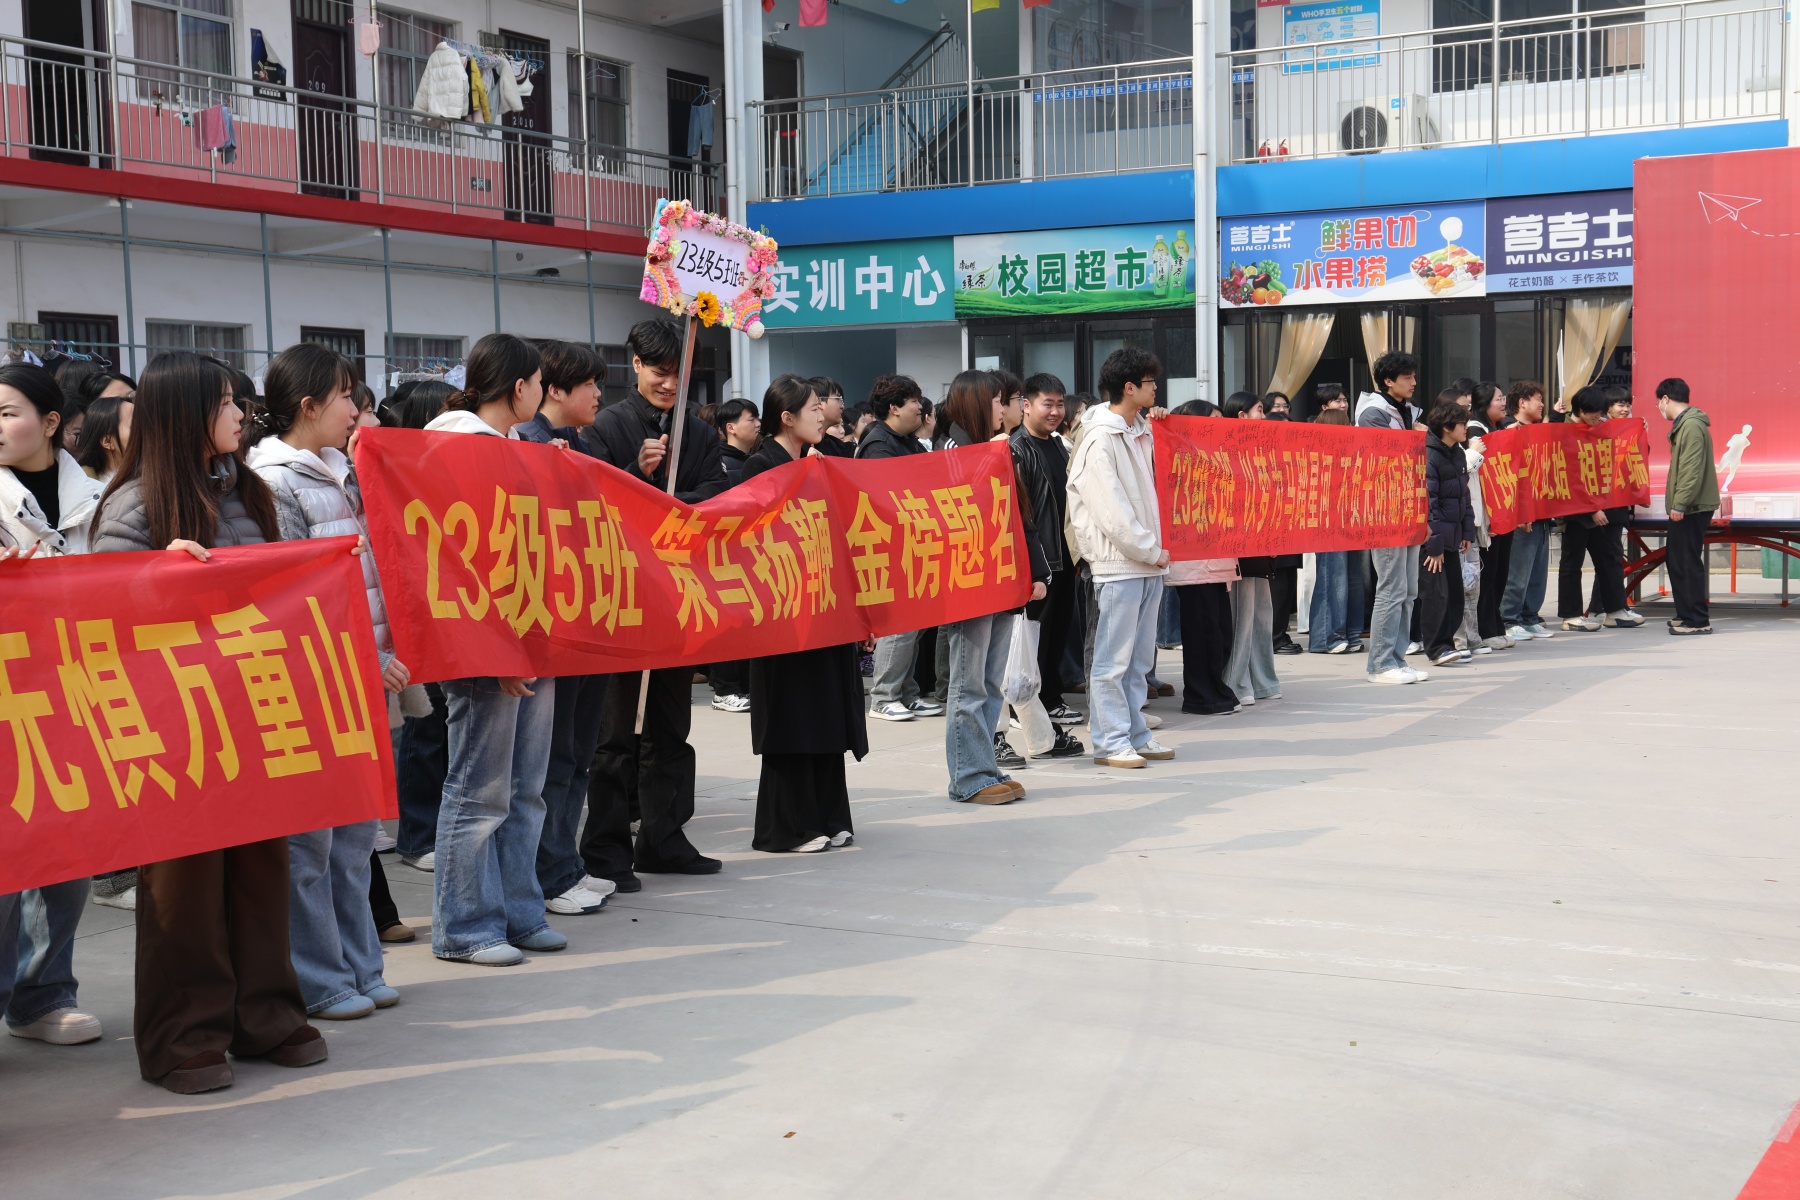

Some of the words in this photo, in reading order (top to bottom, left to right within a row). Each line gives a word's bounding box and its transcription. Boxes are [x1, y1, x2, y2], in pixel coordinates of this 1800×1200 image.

[308, 79, 326, 93] 209
[513, 117, 534, 128] 2010
[1231, 242, 1291, 252] MINGJISHI
[1320, 215, 1417, 252] 鲜果切
[676, 239, 740, 288] 23级5班
[997, 246, 1148, 297] 校园超市
[1293, 255, 1387, 290] 水果捞
[1506, 247, 1632, 265] MINGJISHI
[763, 255, 946, 313] 实训中心
[1508, 275, 1555, 288] 花式奶酪
[1572, 271, 1619, 286] 手作茶饮
[1172, 446, 1236, 534] 23级3班
[404, 485, 643, 640] 23级5班
[650, 498, 837, 633] 策马扬鞭
[846, 475, 1017, 607] 金榜题名
[0, 596, 379, 824] 无惧万重山
